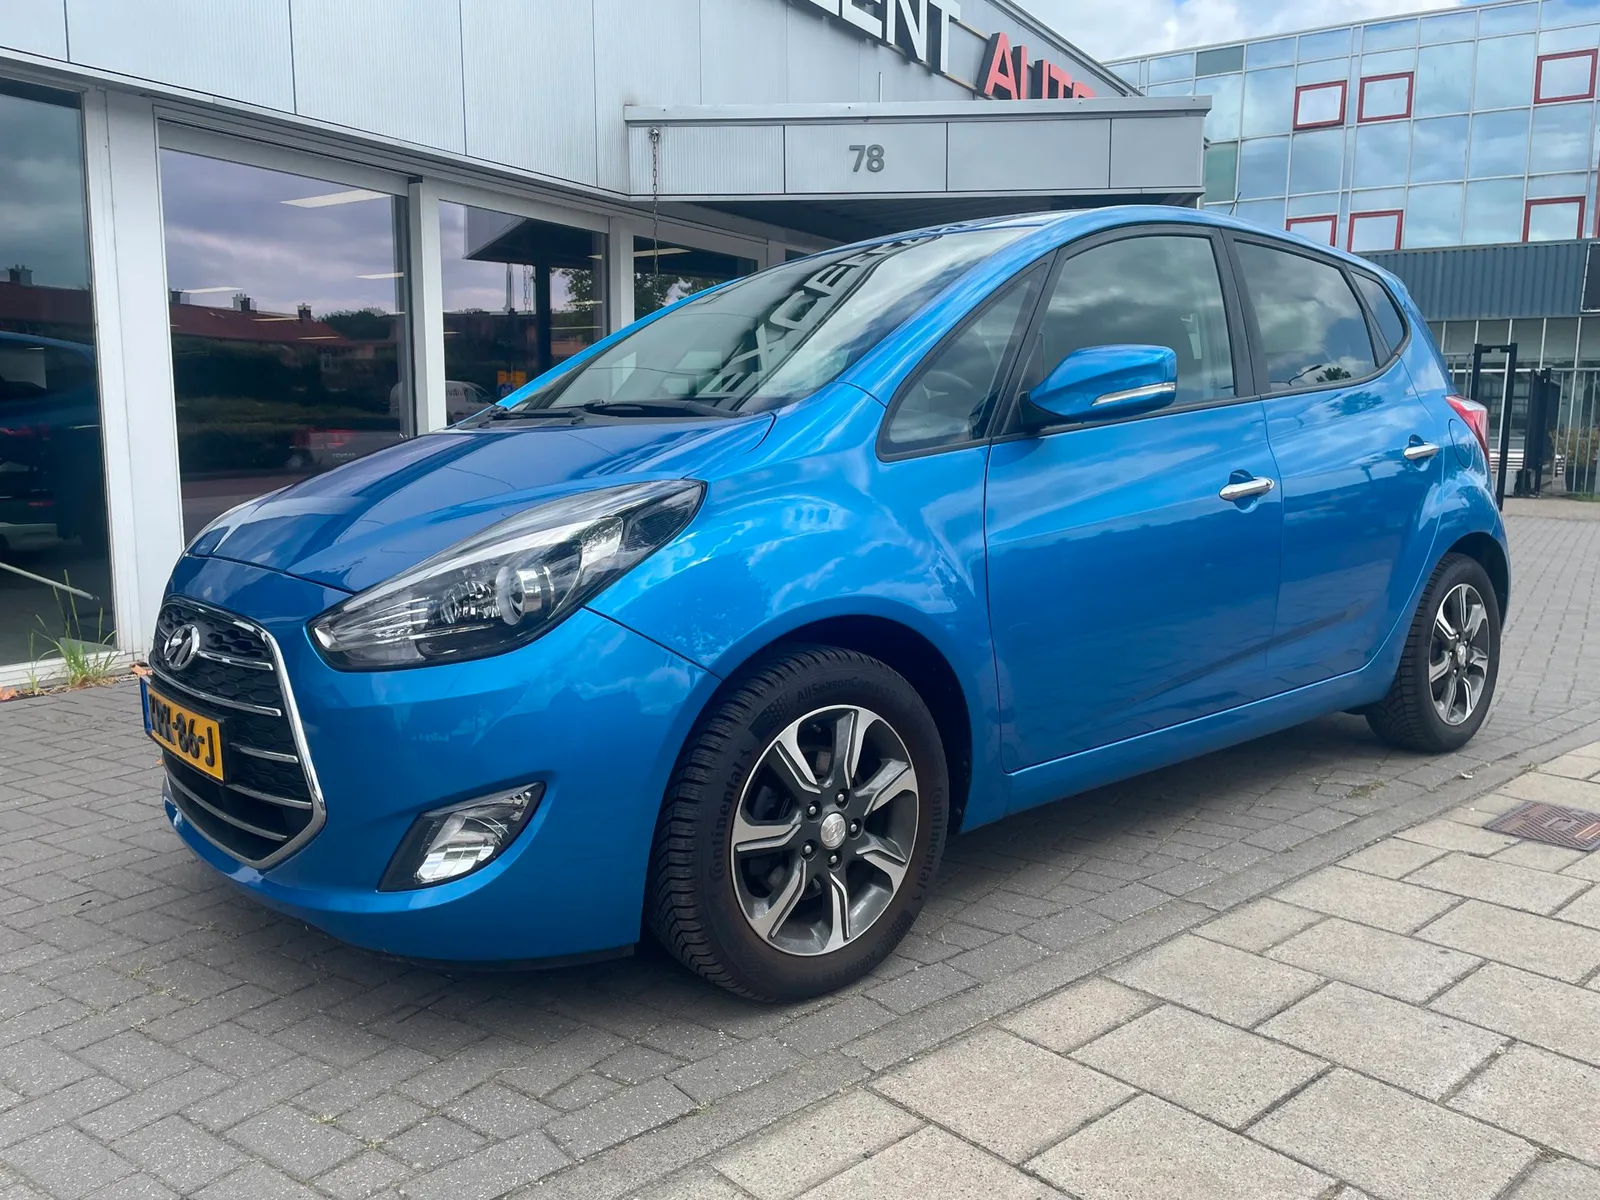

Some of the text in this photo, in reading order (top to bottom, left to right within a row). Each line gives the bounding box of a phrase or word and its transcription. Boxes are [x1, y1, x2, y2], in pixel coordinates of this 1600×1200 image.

[809, 0, 1096, 99] NT AUT
[848, 144, 885, 173] 78
[709, 761, 746, 882] Continental
